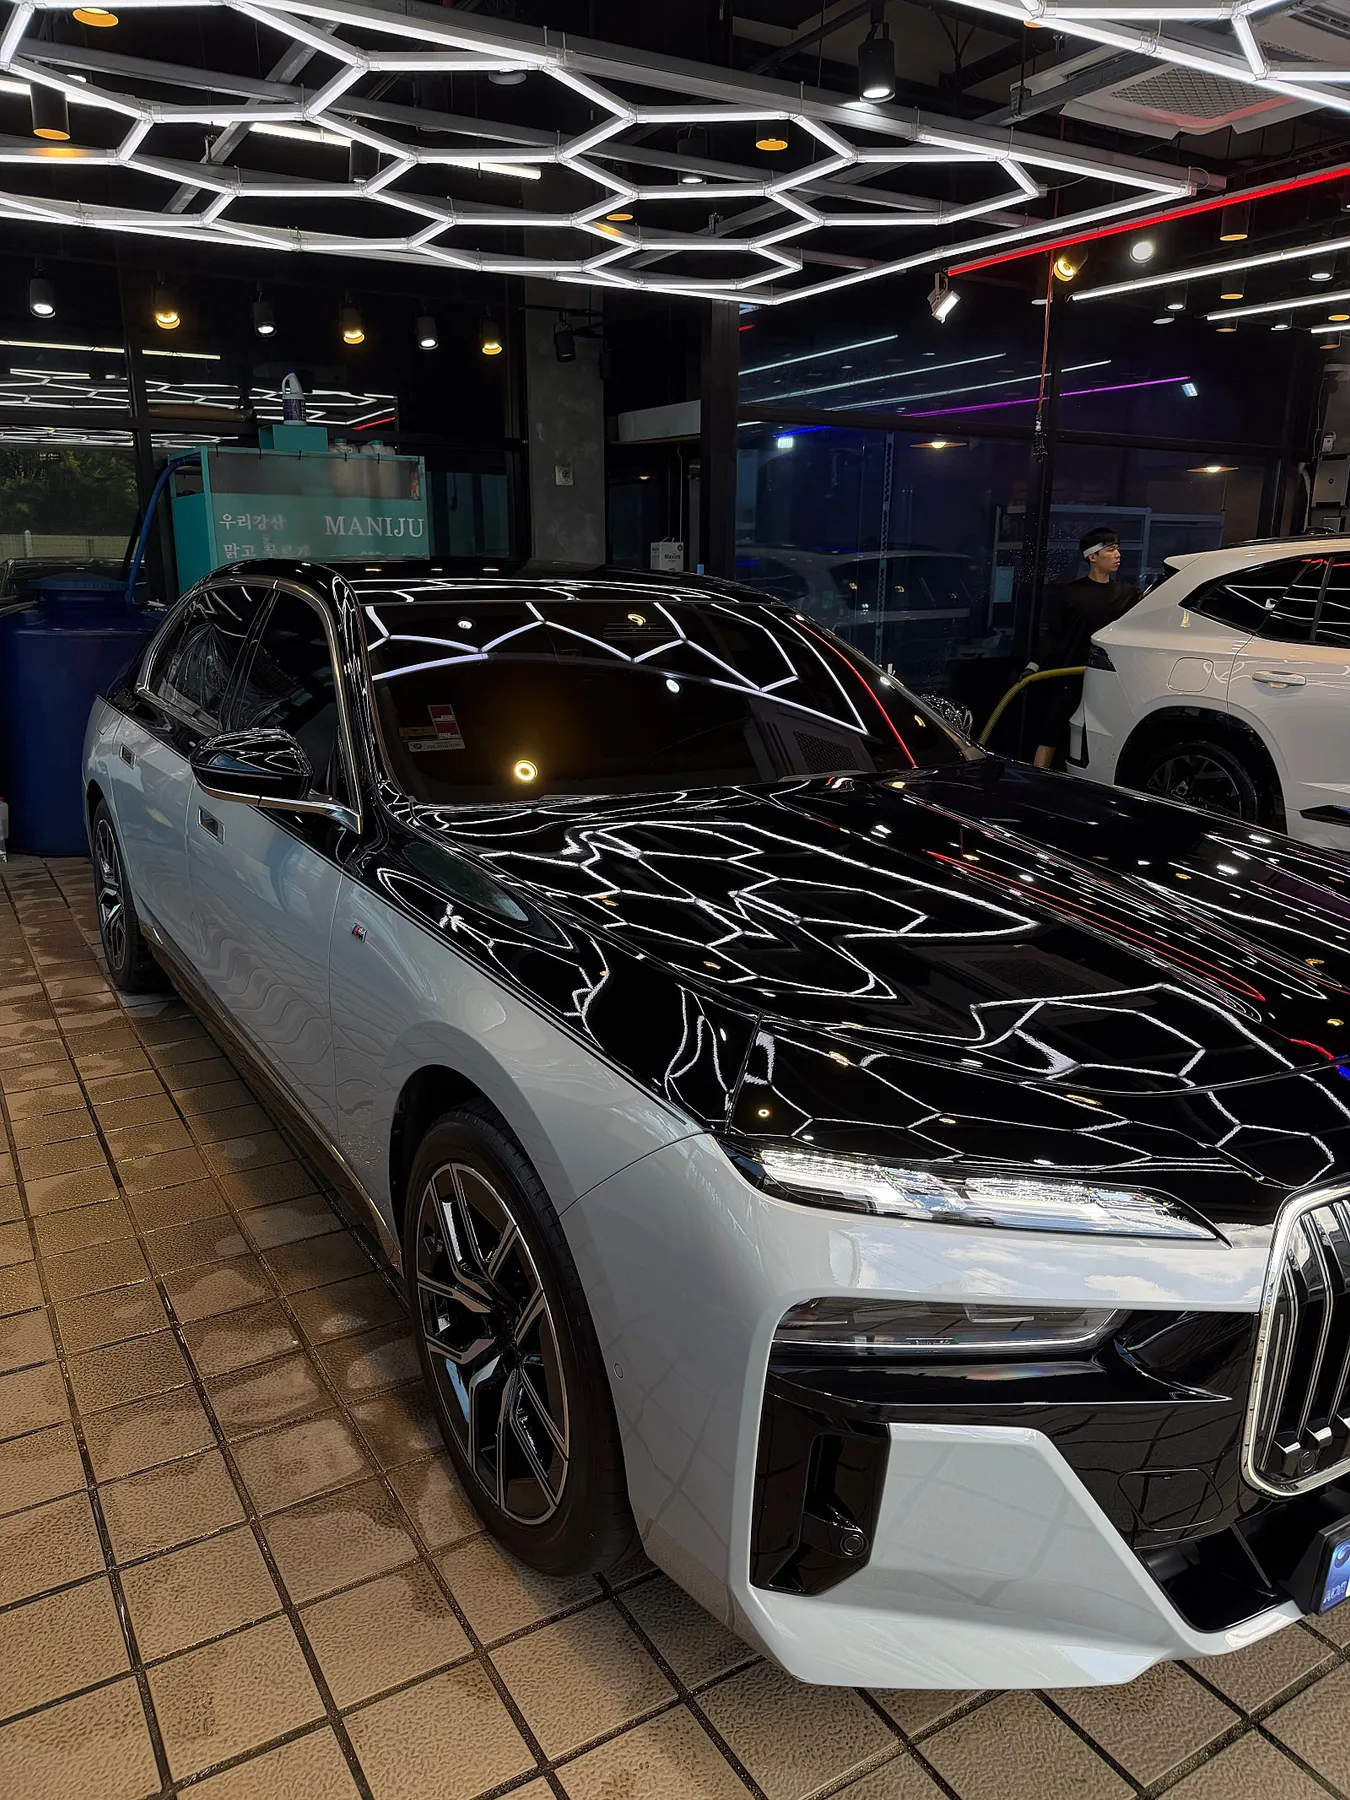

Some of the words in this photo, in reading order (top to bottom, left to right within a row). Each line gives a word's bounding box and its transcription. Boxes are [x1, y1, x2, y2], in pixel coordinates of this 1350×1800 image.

[218, 512, 286, 531] 우리강산
[324, 515, 424, 537] MANIJU
[223, 542, 257, 559] 맑고
